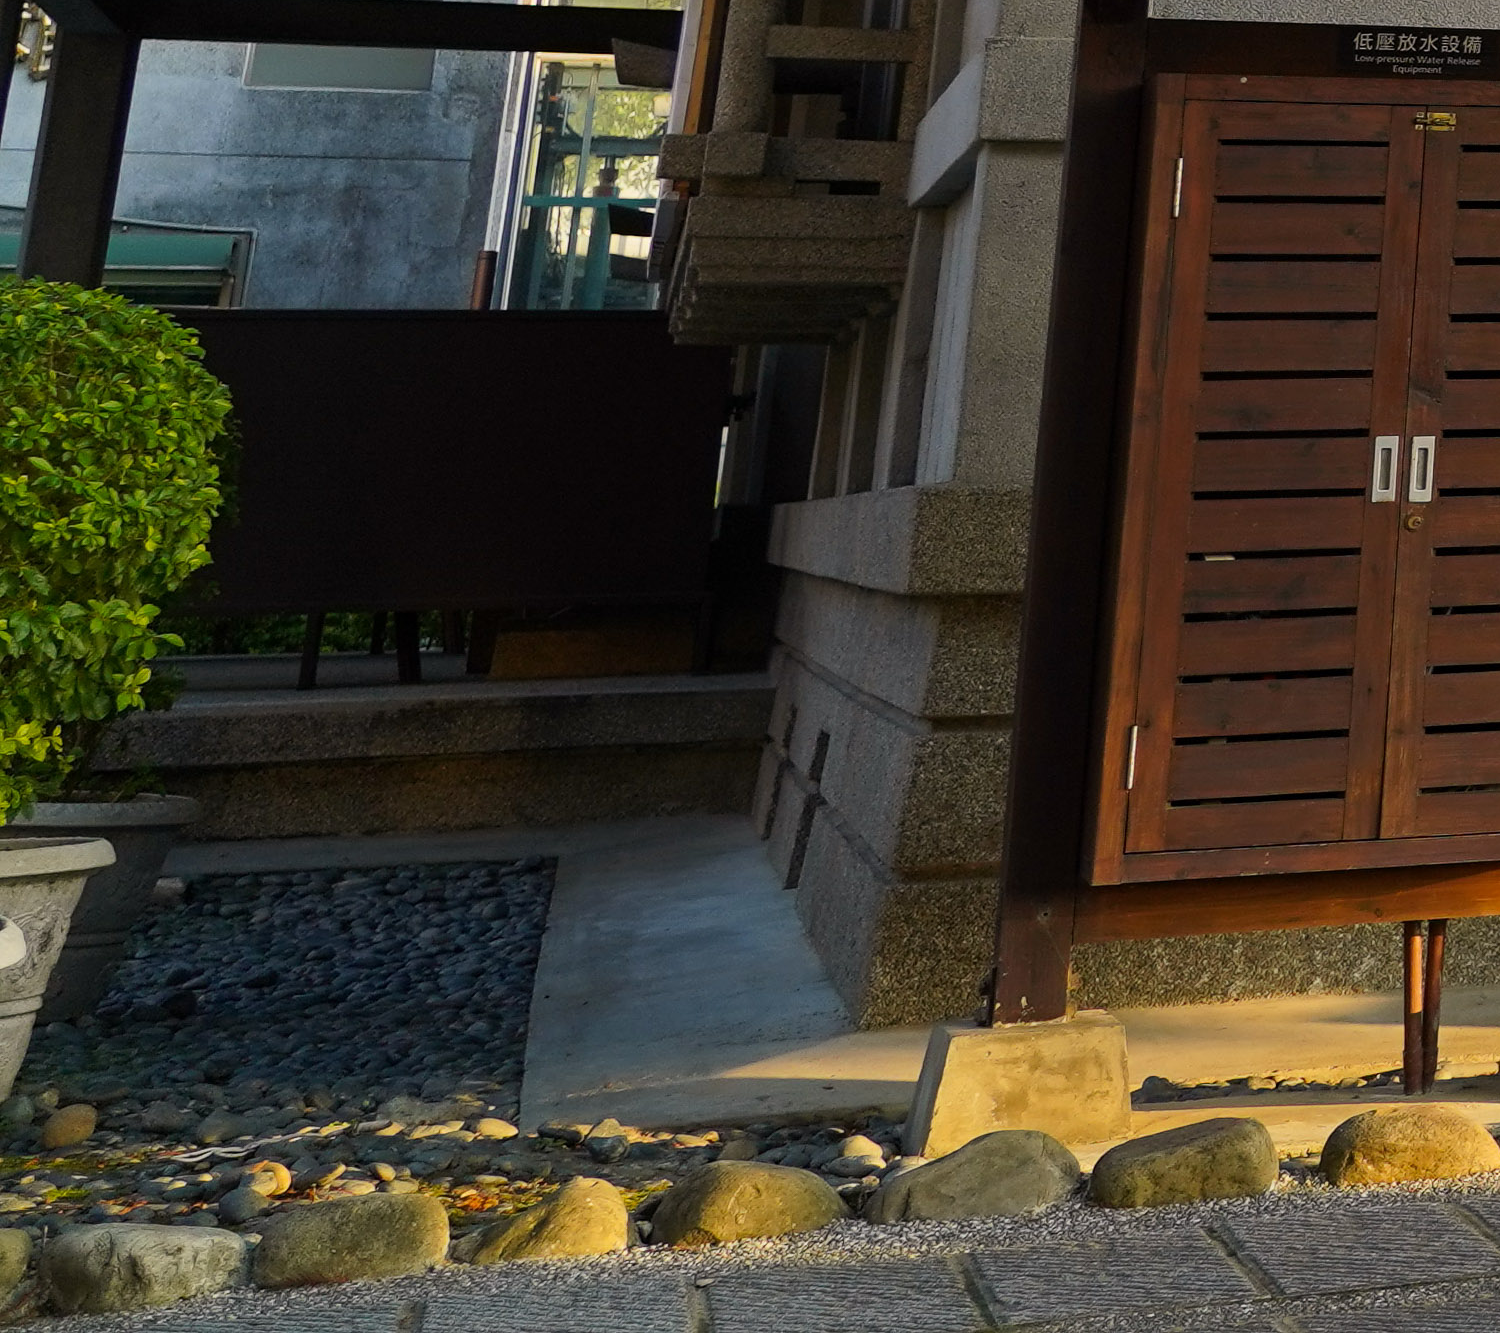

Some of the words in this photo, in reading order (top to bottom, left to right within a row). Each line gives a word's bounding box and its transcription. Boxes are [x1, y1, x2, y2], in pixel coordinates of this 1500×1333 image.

[1353, 32, 1483, 54] 低壓放水設備
[1355, 54, 1415, 65] Low-pressure
[1416, 56, 1445, 64] Water
[1447, 57, 1481, 66] Release
[1392, 65, 1442, 75] Equipment
